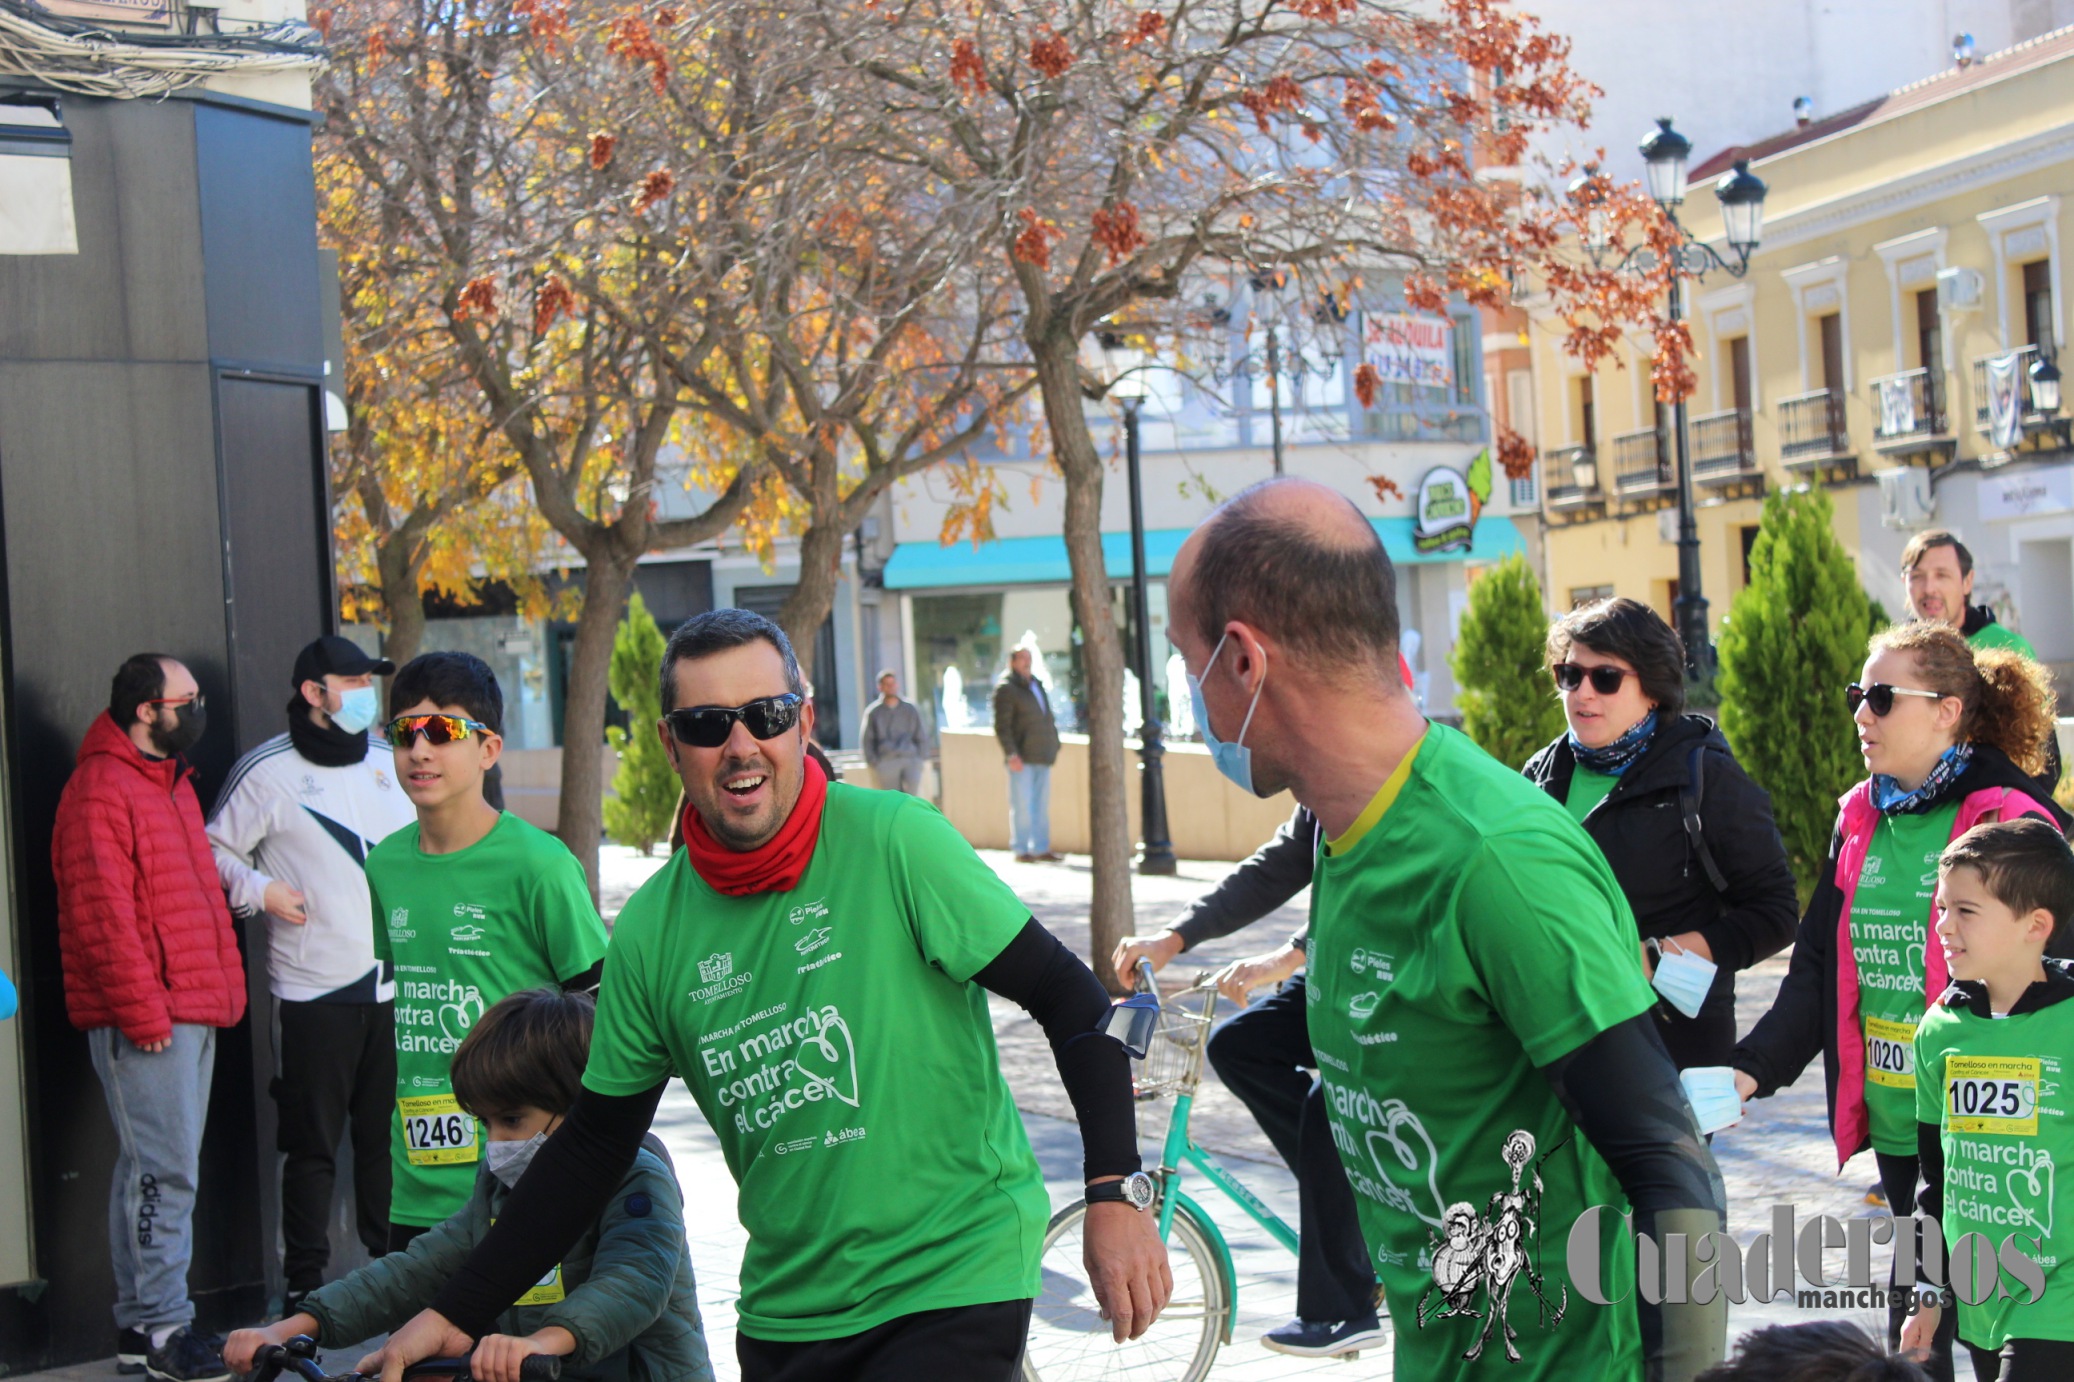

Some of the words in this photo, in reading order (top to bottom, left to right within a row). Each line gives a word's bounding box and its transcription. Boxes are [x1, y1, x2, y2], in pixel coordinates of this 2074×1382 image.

[1869, 907, 1901, 917] TOMELLOSO
[1849, 922, 1860, 939] n
[1863, 920, 1927, 942] march
[1853, 944, 1900, 966] ontra
[403, 979, 480, 1002] marcha
[688, 971, 753, 1003] TOMELLOSO
[1866, 967, 1923, 993] cáncer
[394, 1003, 435, 1026] ontra
[740, 1003, 787, 1029] TOMELLOSO
[702, 1047, 737, 1077] En
[738, 1005, 839, 1063] marcha
[1868, 1037, 1904, 1072] 1020
[1950, 1061, 1986, 1069] Tomelloso
[1999, 1062, 2032, 1070] marcha
[718, 1059, 796, 1107] contra
[1949, 1081, 2020, 1116] 1025
[406, 1115, 463, 1148] 1246
[734, 1105, 754, 1134] el
[839, 1127, 866, 1140] ábea
[1960, 1141, 2051, 1168] marcha
[1948, 1166, 1997, 1194] ontra
[139, 1173, 161, 1246] adidas
[1959, 1195, 2034, 1227] cáncer
